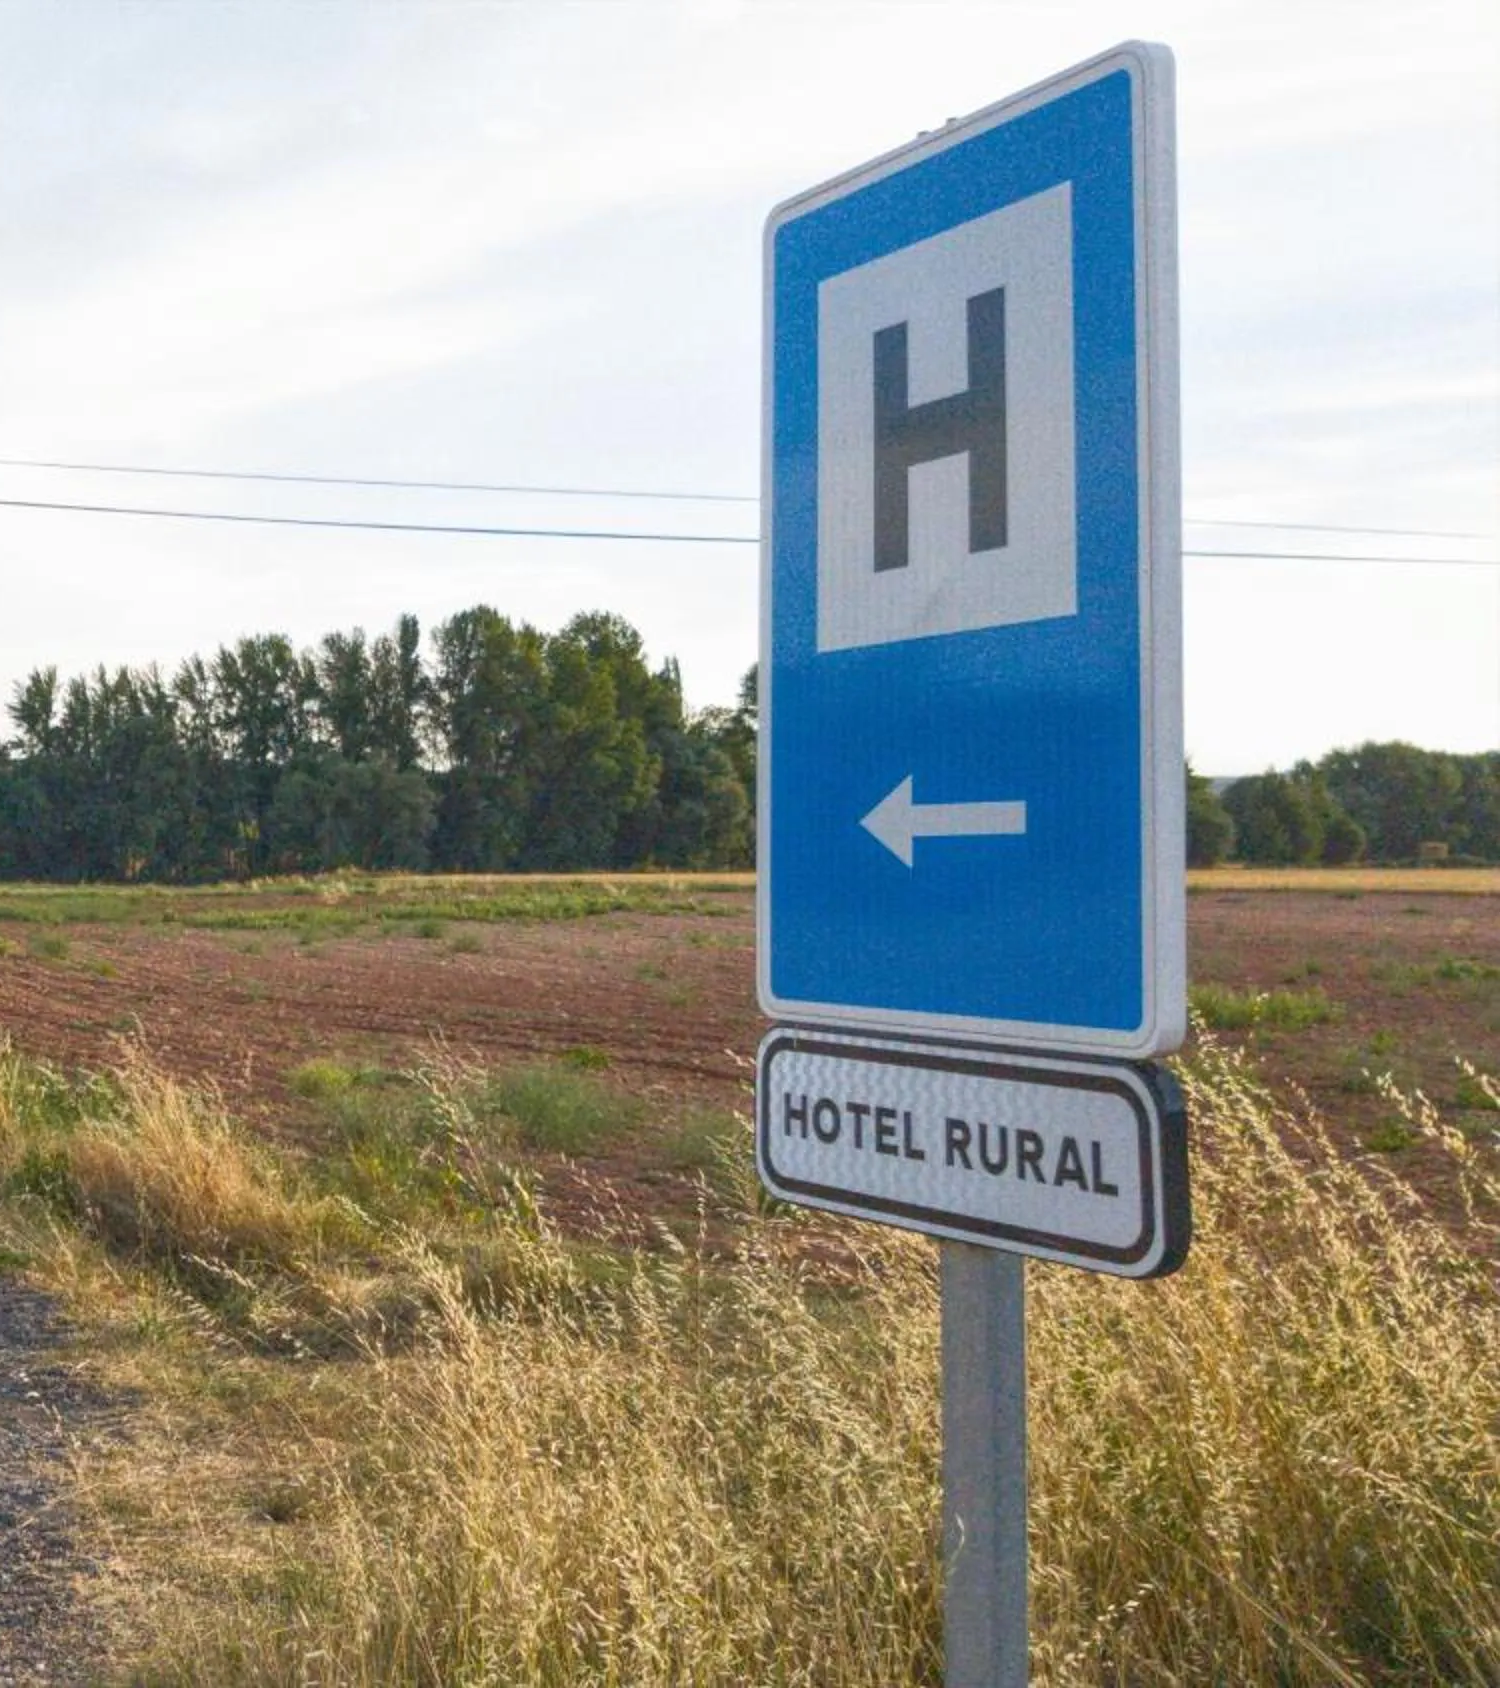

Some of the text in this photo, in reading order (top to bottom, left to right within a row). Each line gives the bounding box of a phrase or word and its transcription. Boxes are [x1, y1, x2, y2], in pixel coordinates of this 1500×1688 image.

[873, 286, 1008, 573] H
[783, 1092, 1119, 1197] HOTEL RURAL
